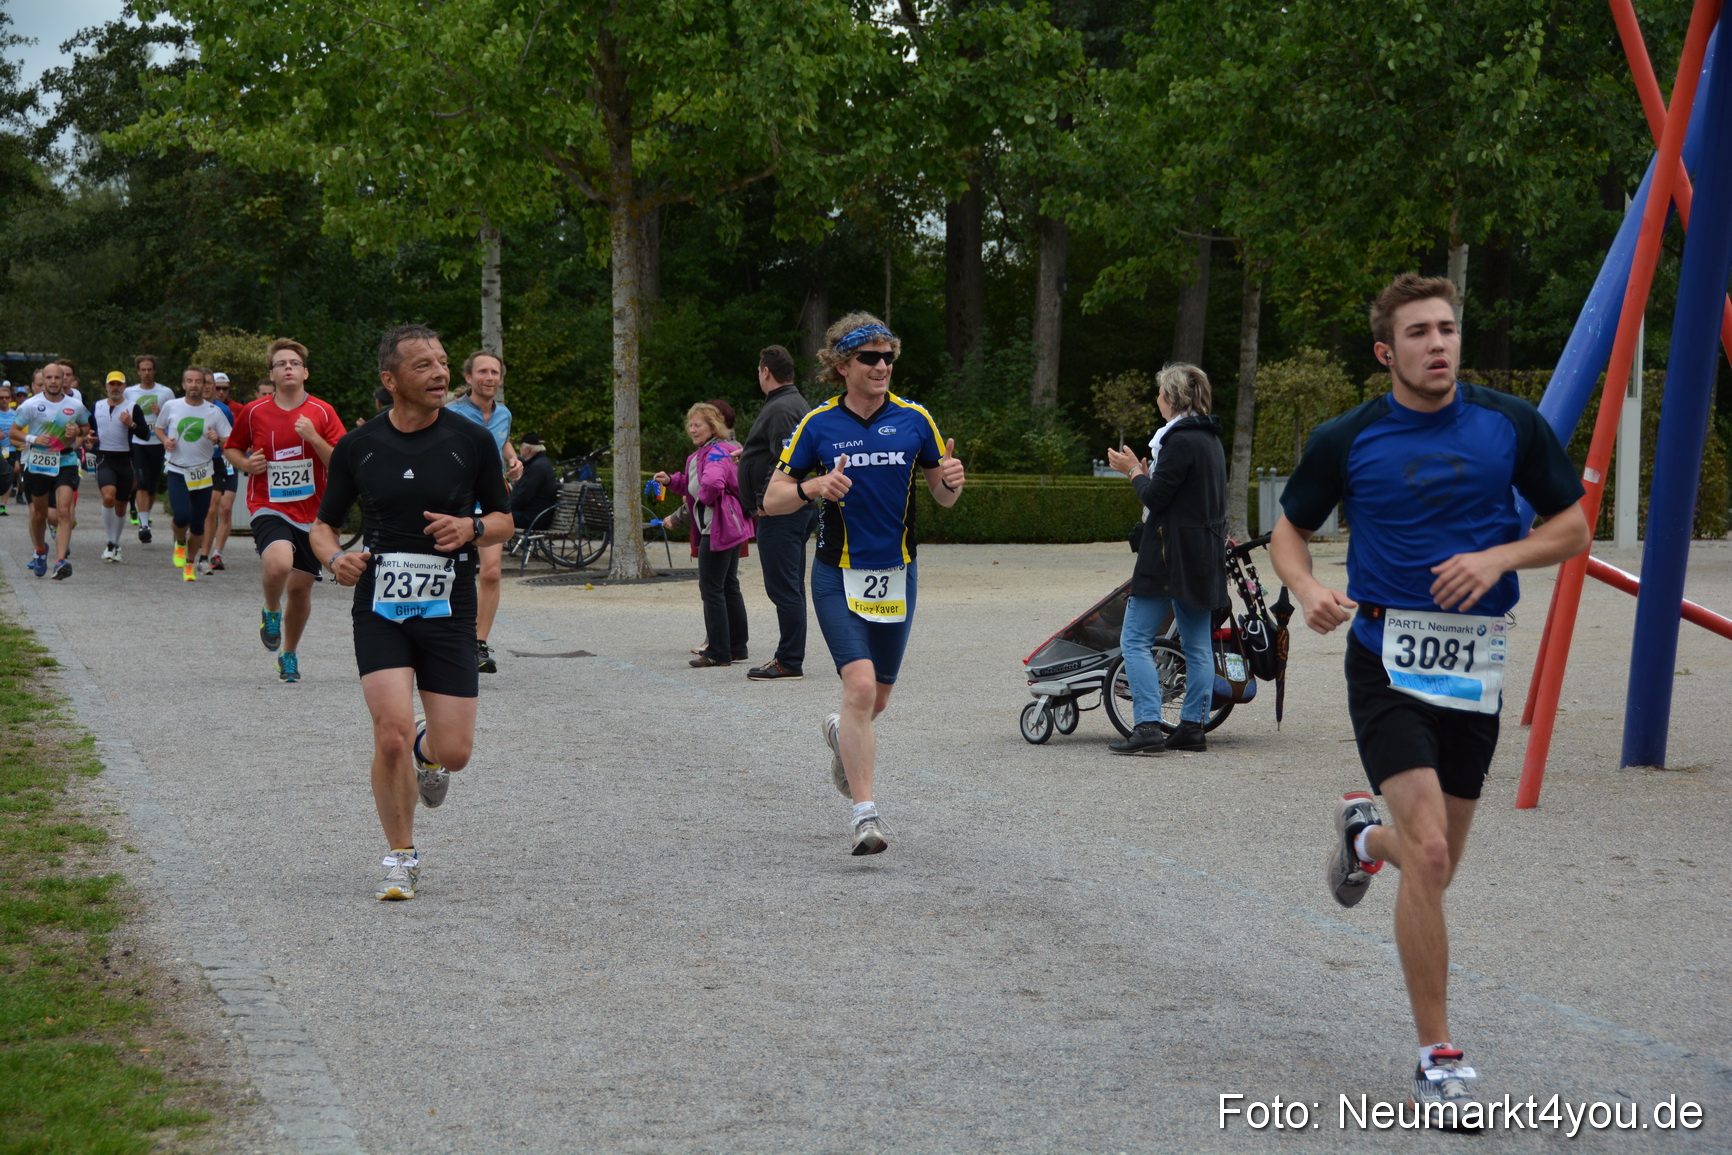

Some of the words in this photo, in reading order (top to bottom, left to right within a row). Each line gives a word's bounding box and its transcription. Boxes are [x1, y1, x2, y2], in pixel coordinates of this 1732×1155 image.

[832, 440, 864, 450] TEAM
[32, 454, 57, 467] 2263
[272, 469, 310, 487] 2524
[282, 489, 302, 497] Stefan
[403, 561, 442, 570] Neumarkt
[383, 571, 447, 599] 2375
[863, 575, 890, 599] 23
[395, 605, 429, 617] Günter
[1388, 617, 1425, 631] PARTL
[1428, 622, 1474, 635] Neumarkt
[1394, 634, 1476, 673] 3081
[1398, 674, 1453, 696] Michael
